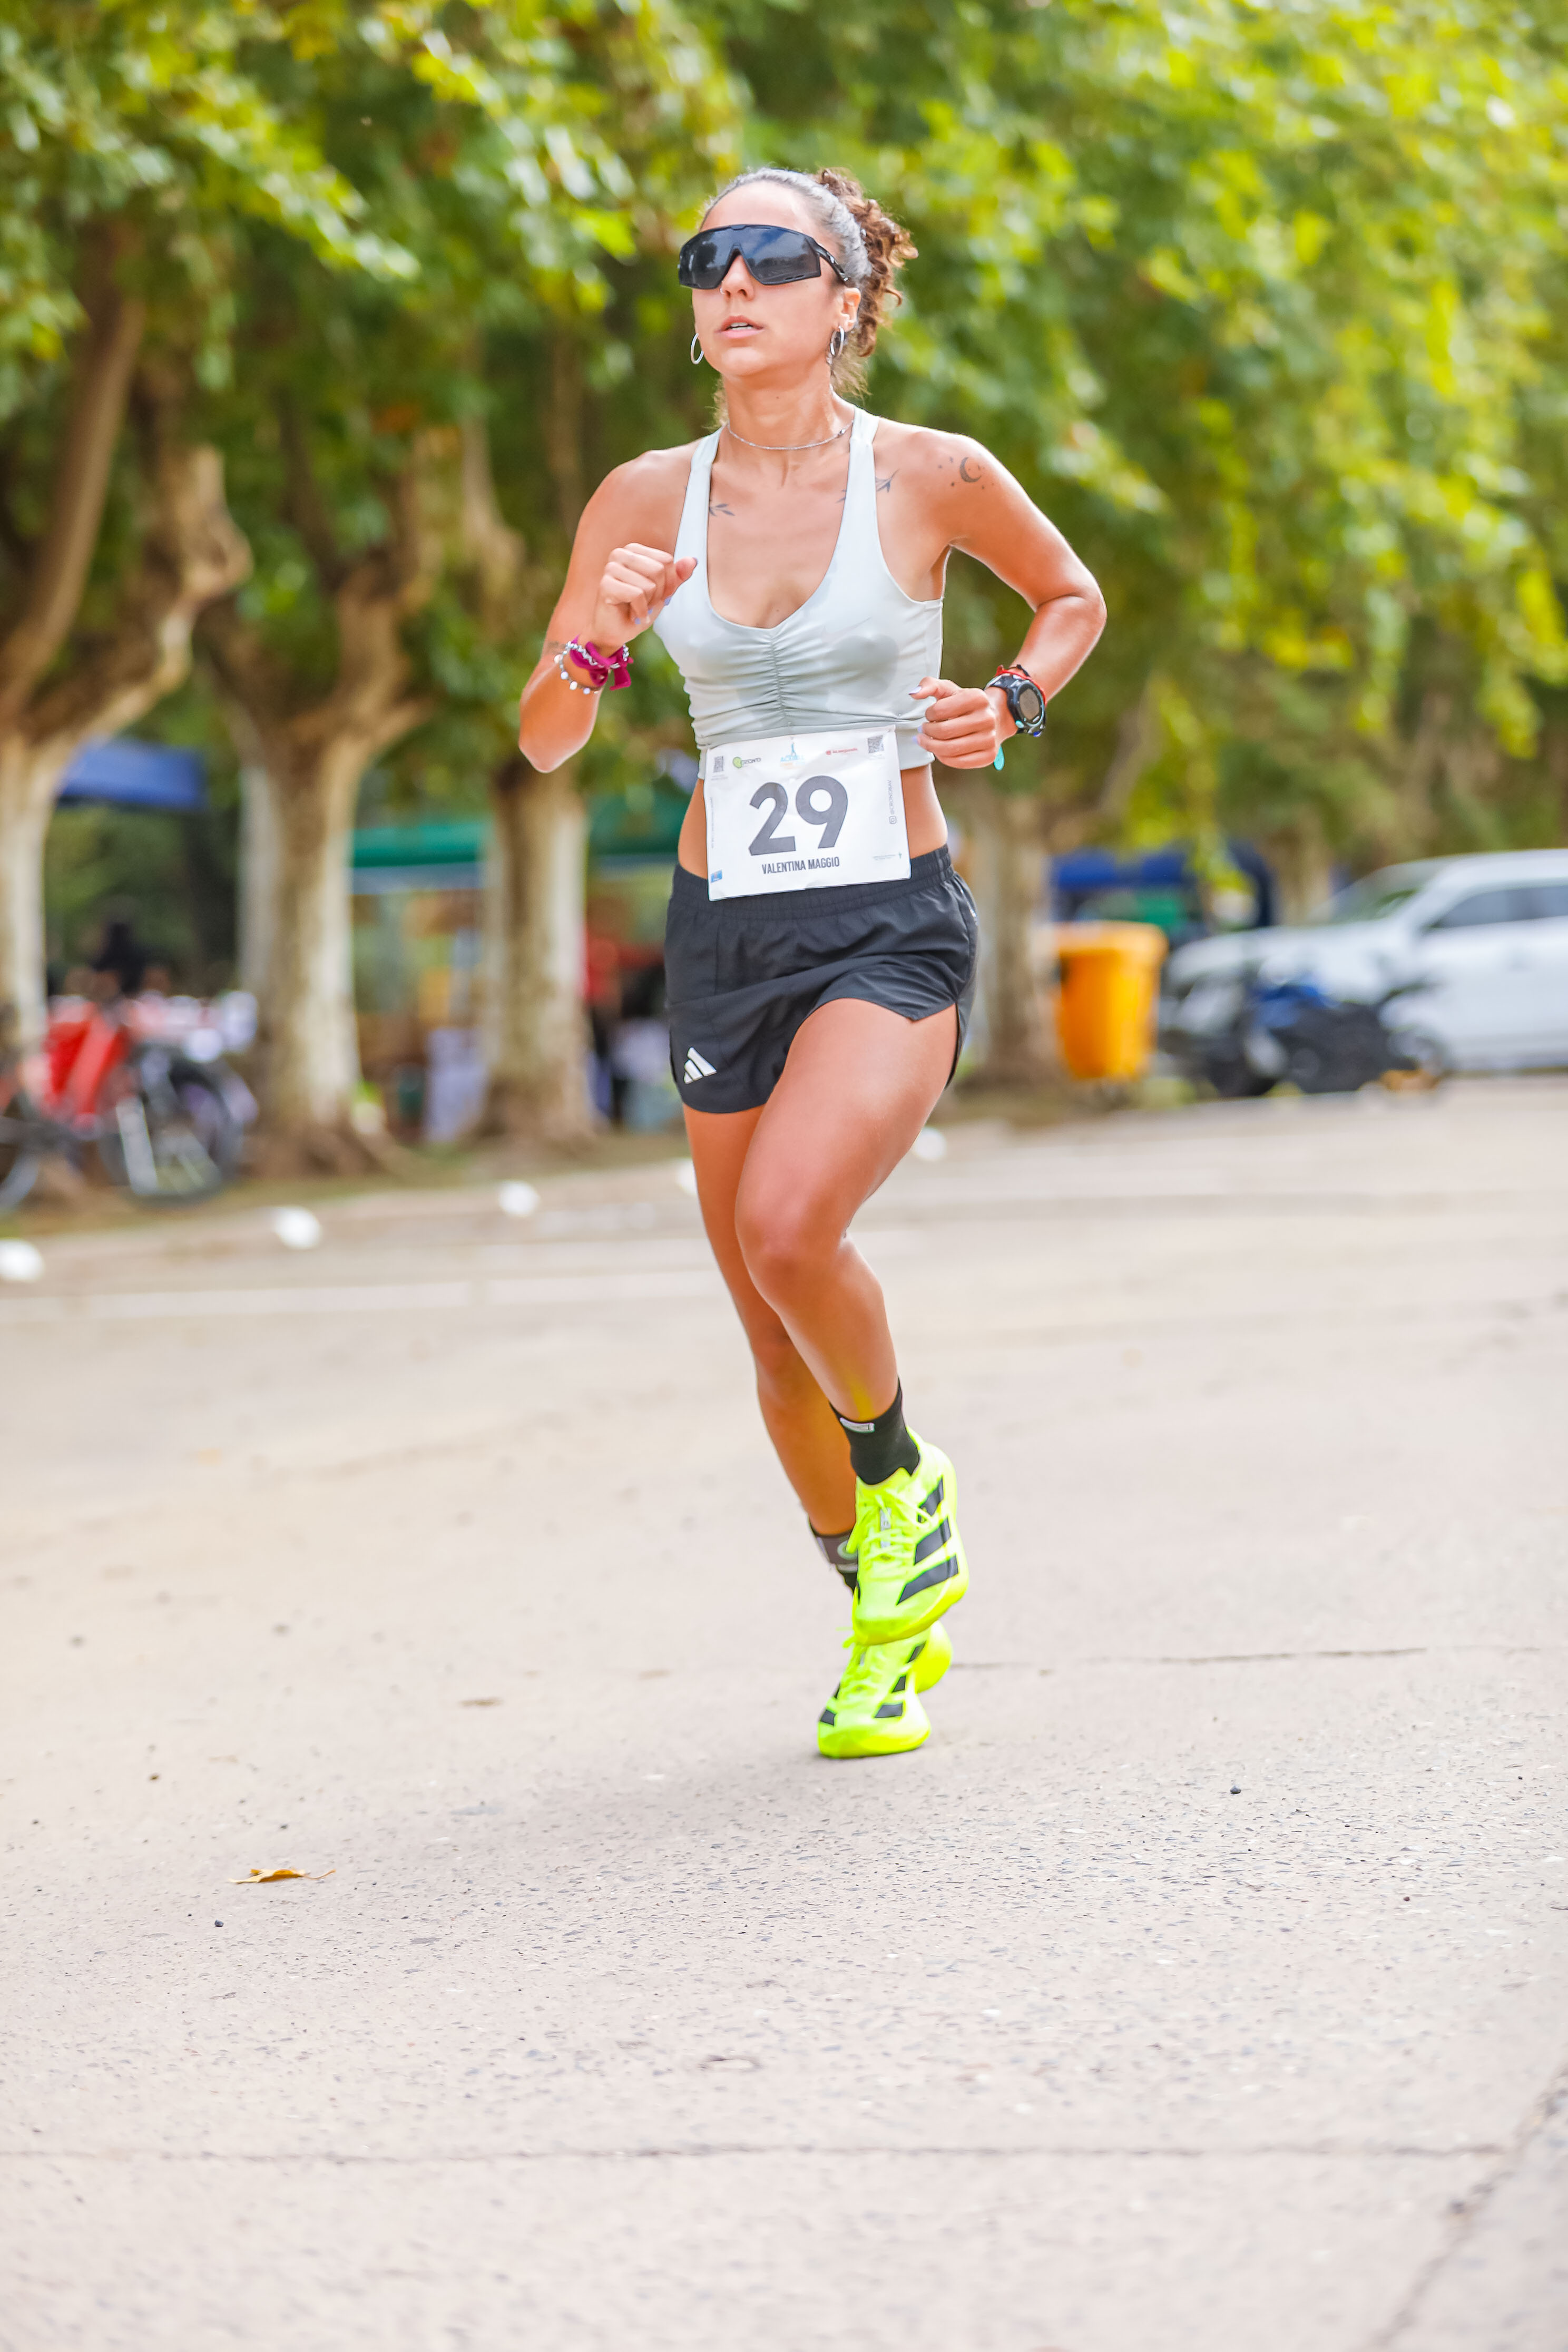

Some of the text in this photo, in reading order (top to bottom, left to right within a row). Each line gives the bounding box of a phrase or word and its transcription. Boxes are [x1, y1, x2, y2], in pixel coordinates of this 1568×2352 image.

[749, 775, 848, 855] 29
[761, 857, 840, 875] VALENTINA MAGGIO
